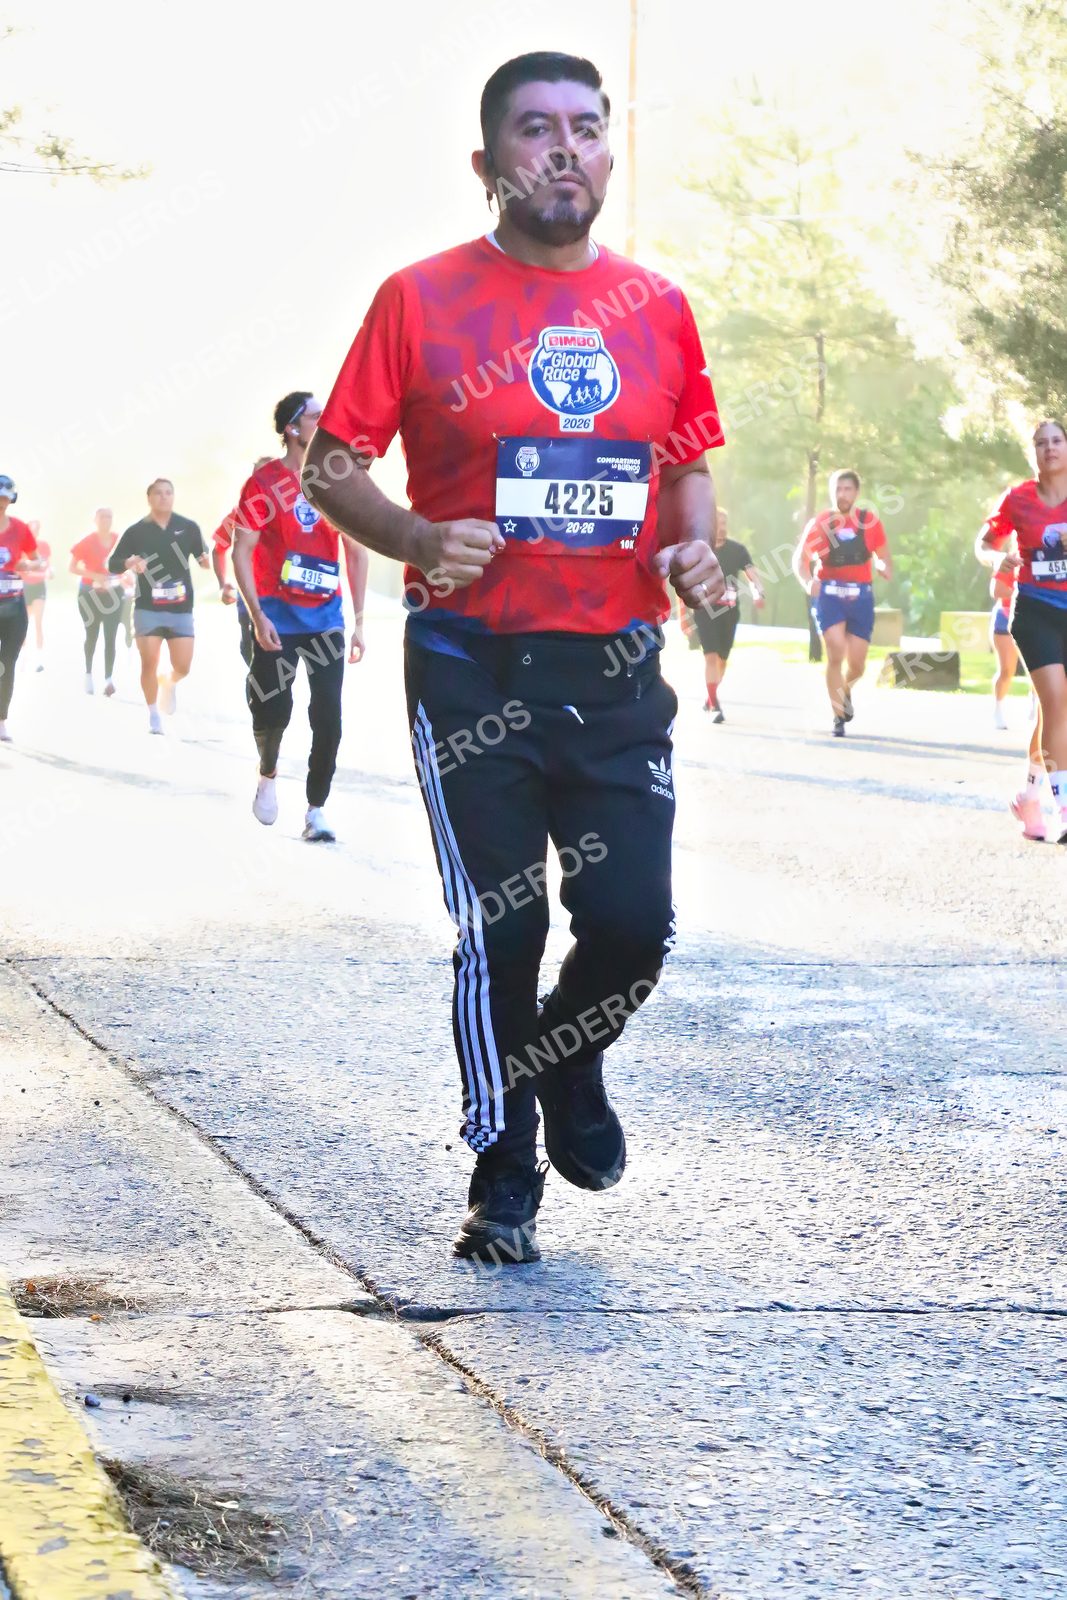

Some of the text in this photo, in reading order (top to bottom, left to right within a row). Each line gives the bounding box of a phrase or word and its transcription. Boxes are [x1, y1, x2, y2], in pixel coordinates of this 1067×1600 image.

[549, 335, 597, 348] BIMBO
[551, 352, 597, 369] Global
[543, 367, 580, 381] Race
[562, 418, 591, 429] 2026
[596, 456, 640, 465] COMPARTIMOS
[544, 482, 614, 516] 4225
[620, 539, 635, 550] 10K
[301, 569, 322, 585] 4315
[651, 784, 674, 800] adidas
